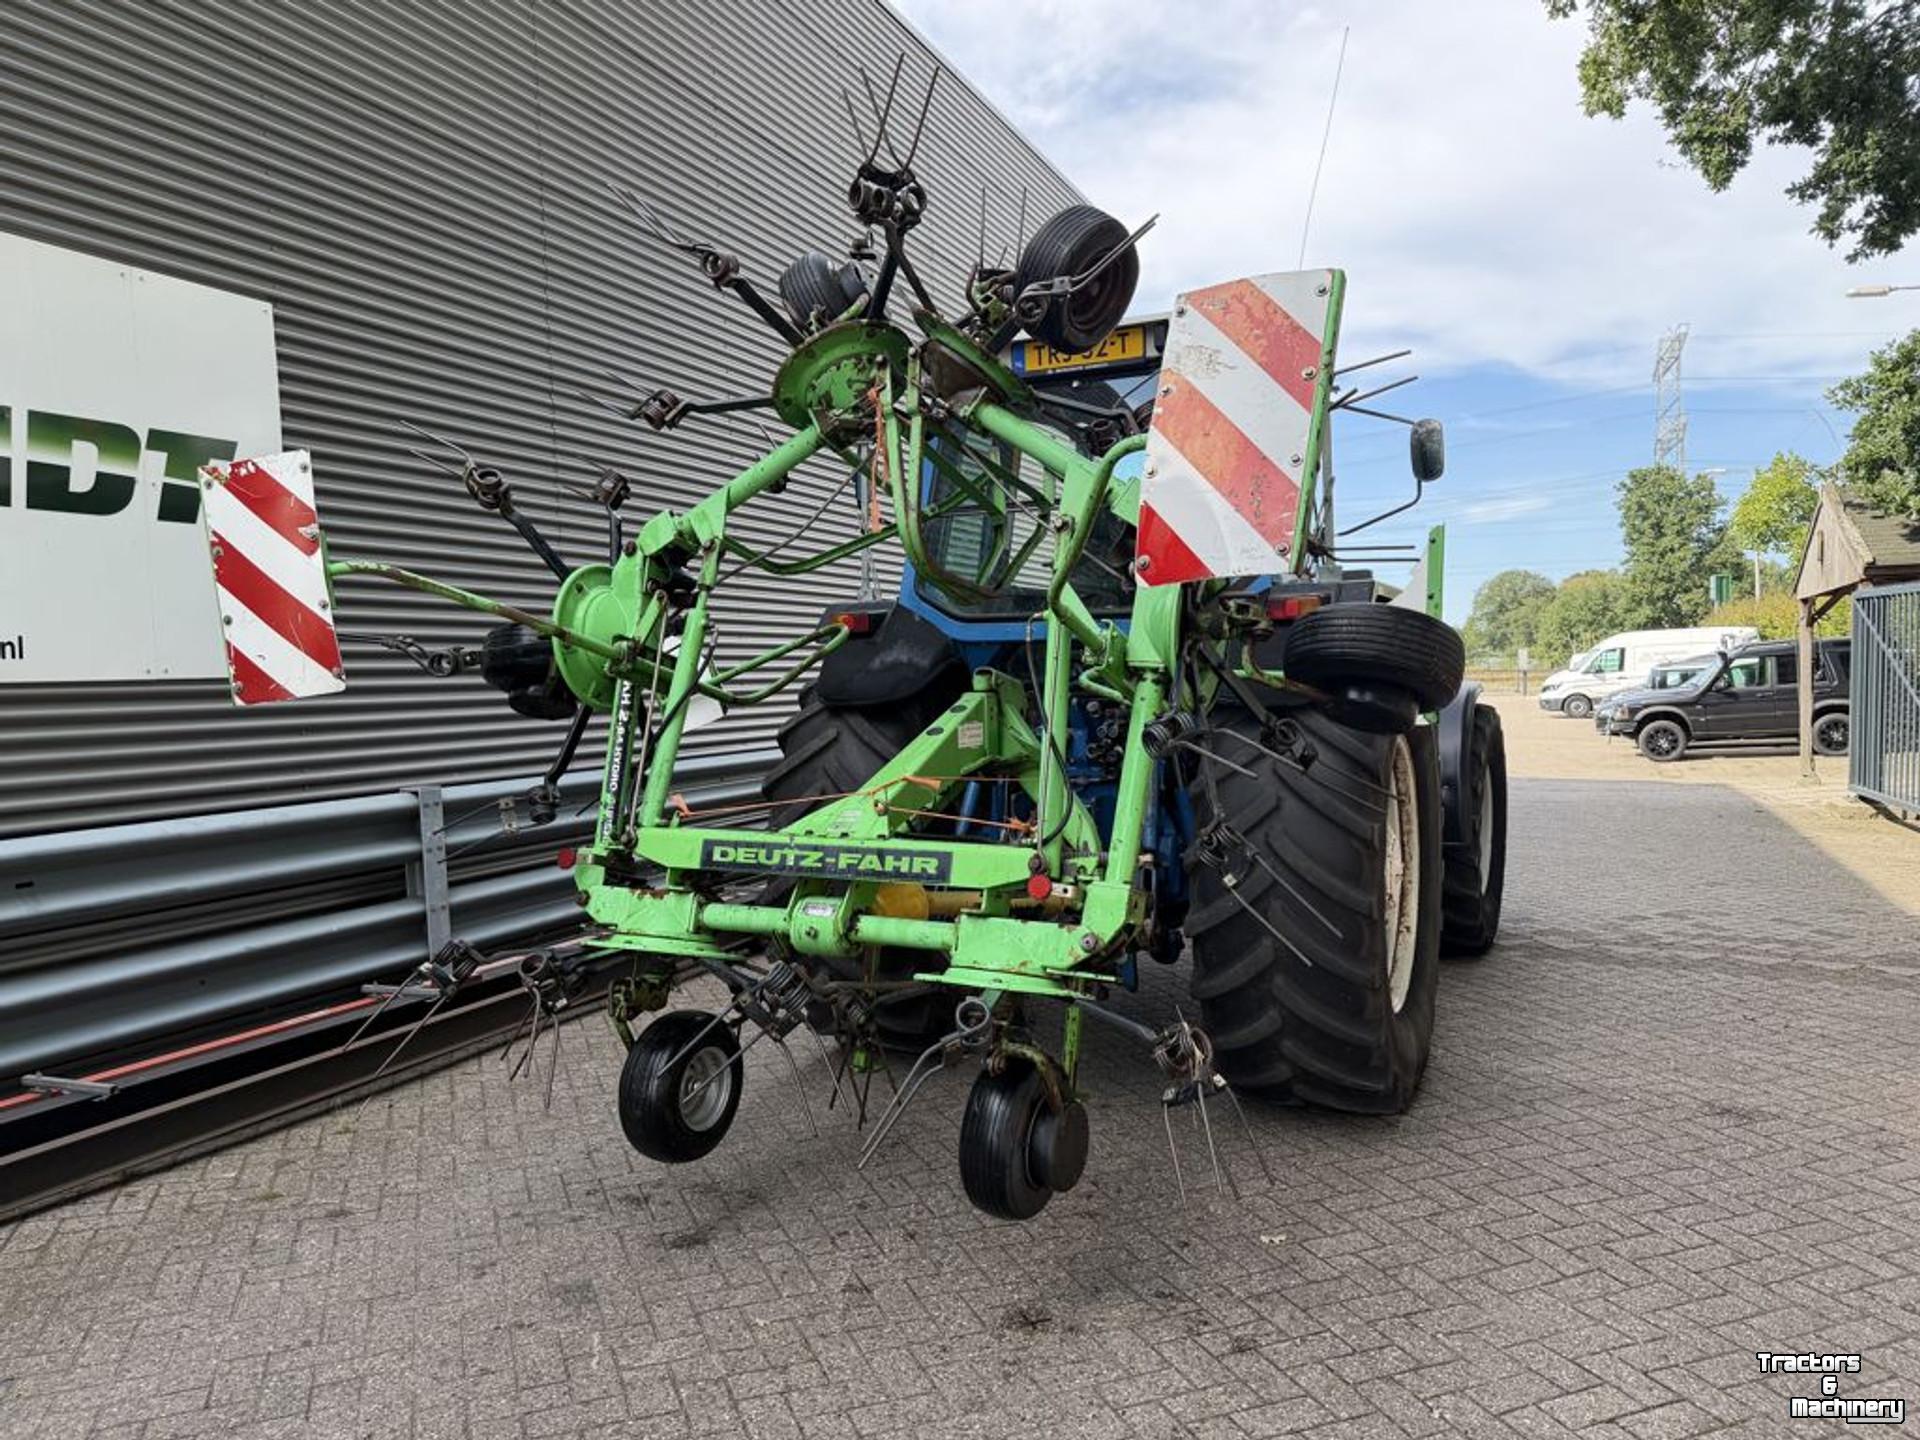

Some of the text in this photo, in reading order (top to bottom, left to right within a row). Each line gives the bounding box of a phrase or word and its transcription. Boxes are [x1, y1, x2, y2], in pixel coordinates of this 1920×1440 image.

[1033, 331, 1130, 367] TR2-T
[0, 404, 238, 524] DT
[711, 845, 939, 875] DEUTZ-FAHR
